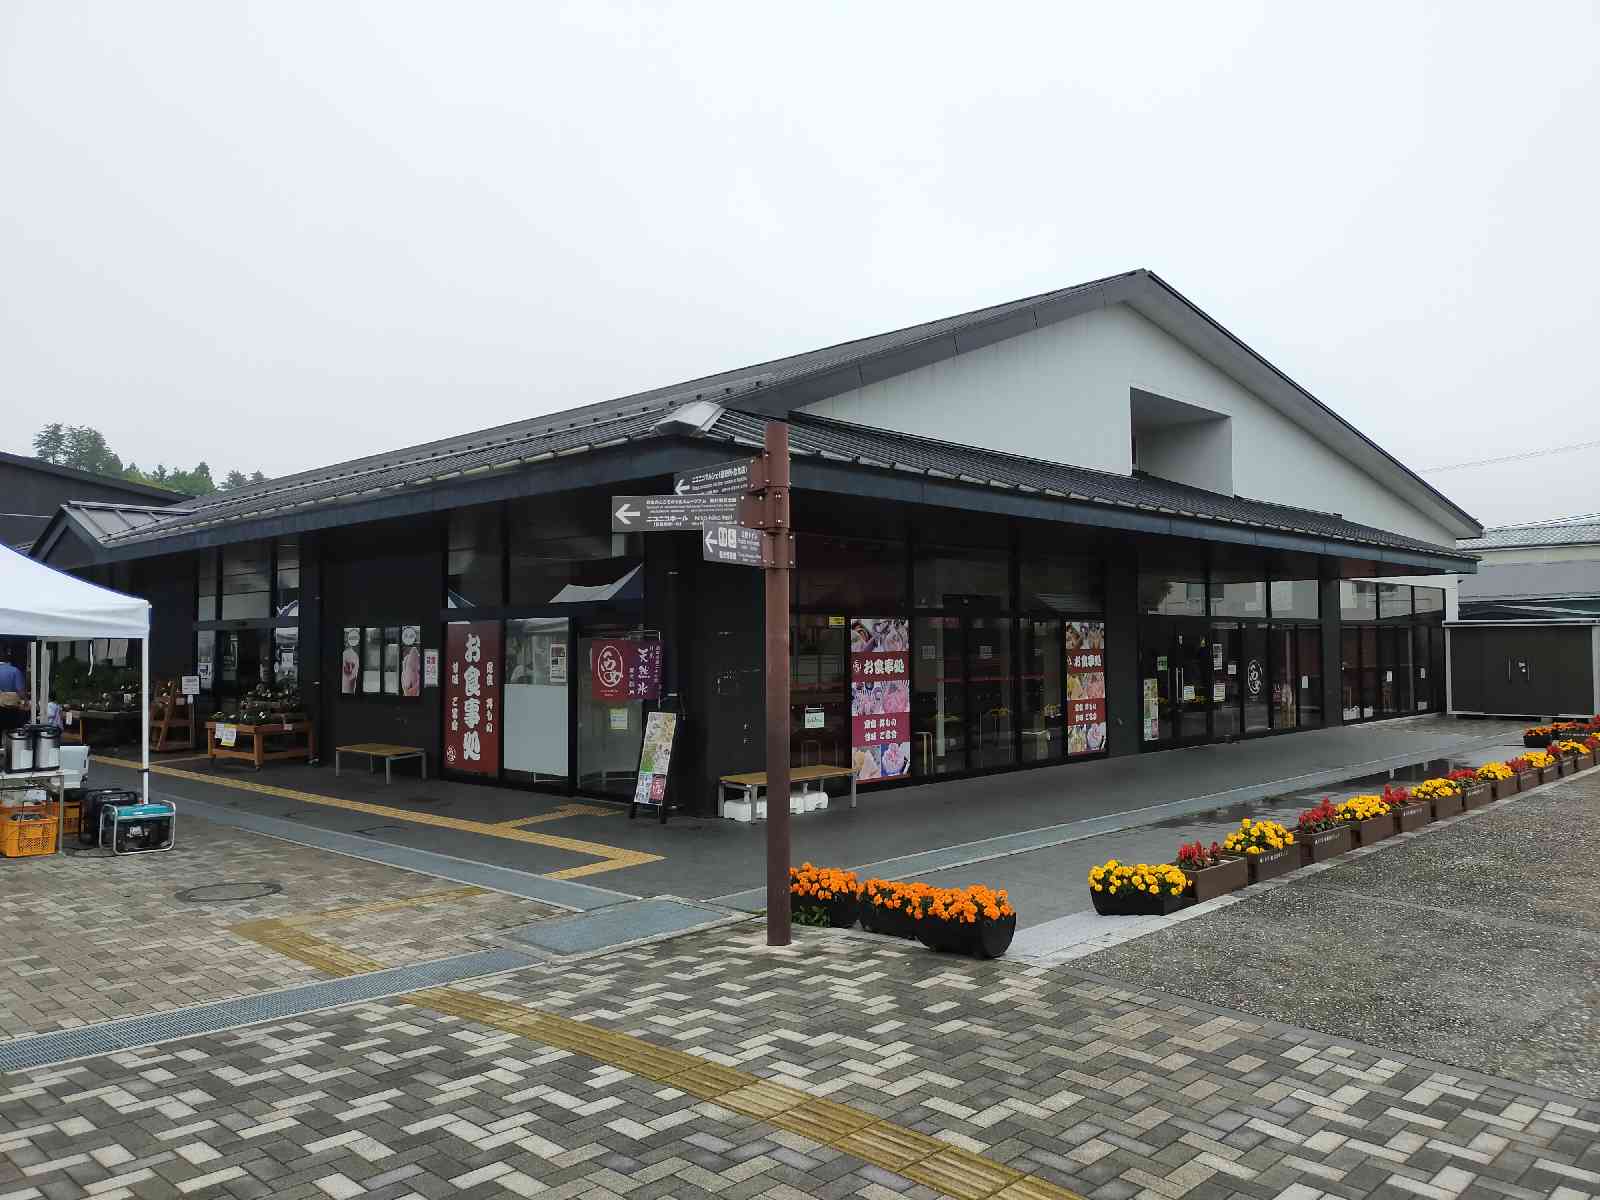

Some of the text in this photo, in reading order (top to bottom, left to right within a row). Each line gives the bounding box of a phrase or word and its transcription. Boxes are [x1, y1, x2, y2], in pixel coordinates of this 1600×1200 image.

[863, 658, 905, 675] お食事処
[1073, 654, 1102, 668] お食事処
[463, 632, 481, 761] お食事処
